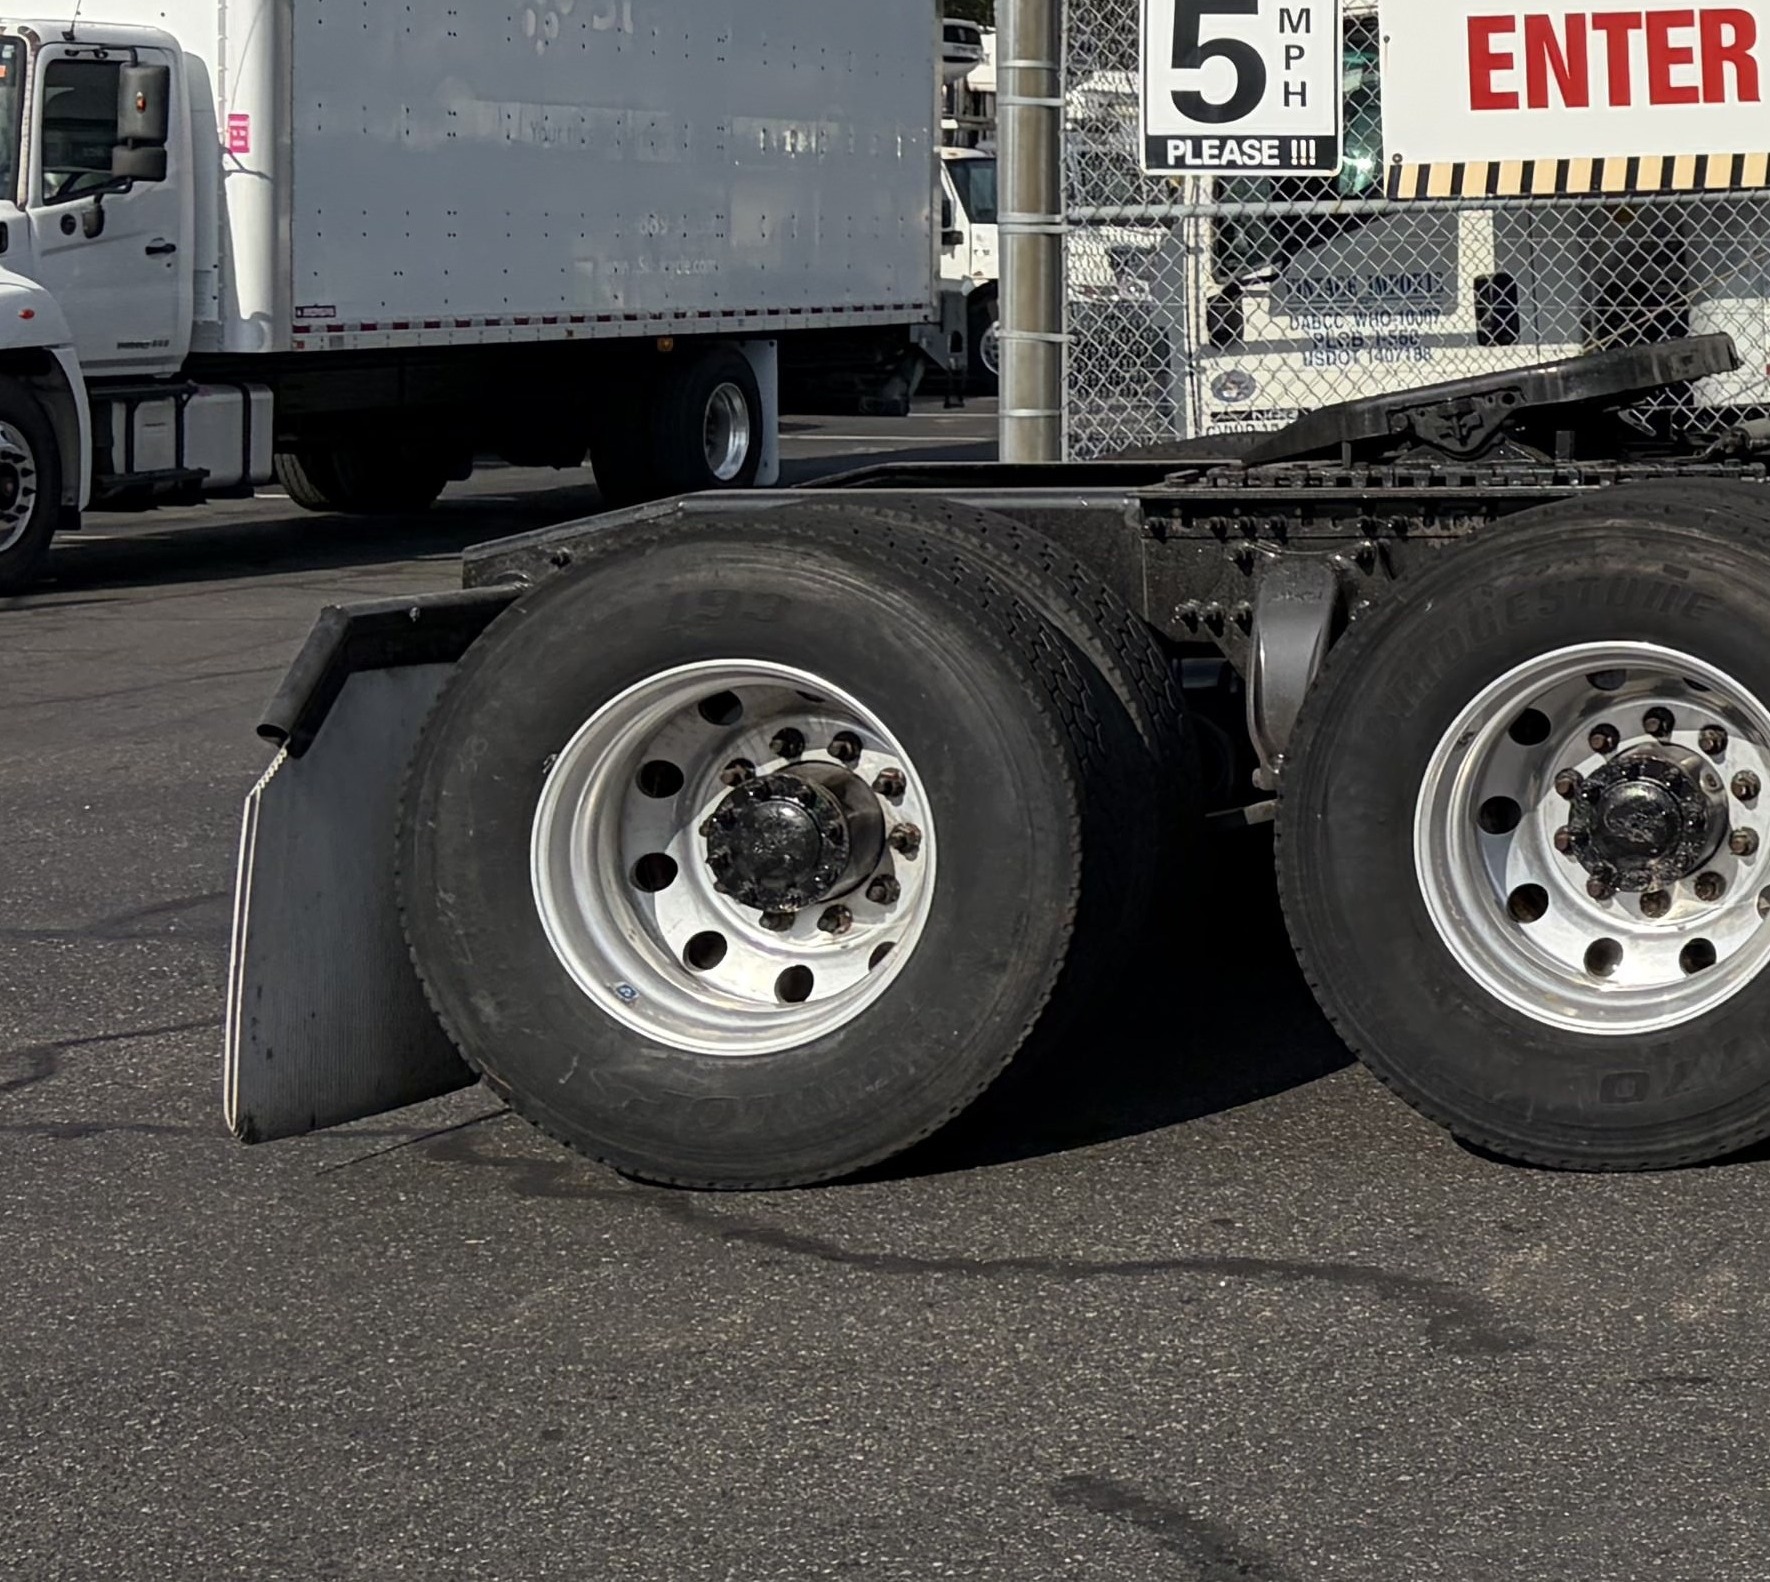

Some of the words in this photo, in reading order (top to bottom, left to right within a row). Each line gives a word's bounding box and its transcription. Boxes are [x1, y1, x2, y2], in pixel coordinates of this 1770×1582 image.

[1466, 8, 1761, 111] ENTER
[1166, 139, 1280, 166] PLEASE
[1290, 139, 1317, 166] !!!
